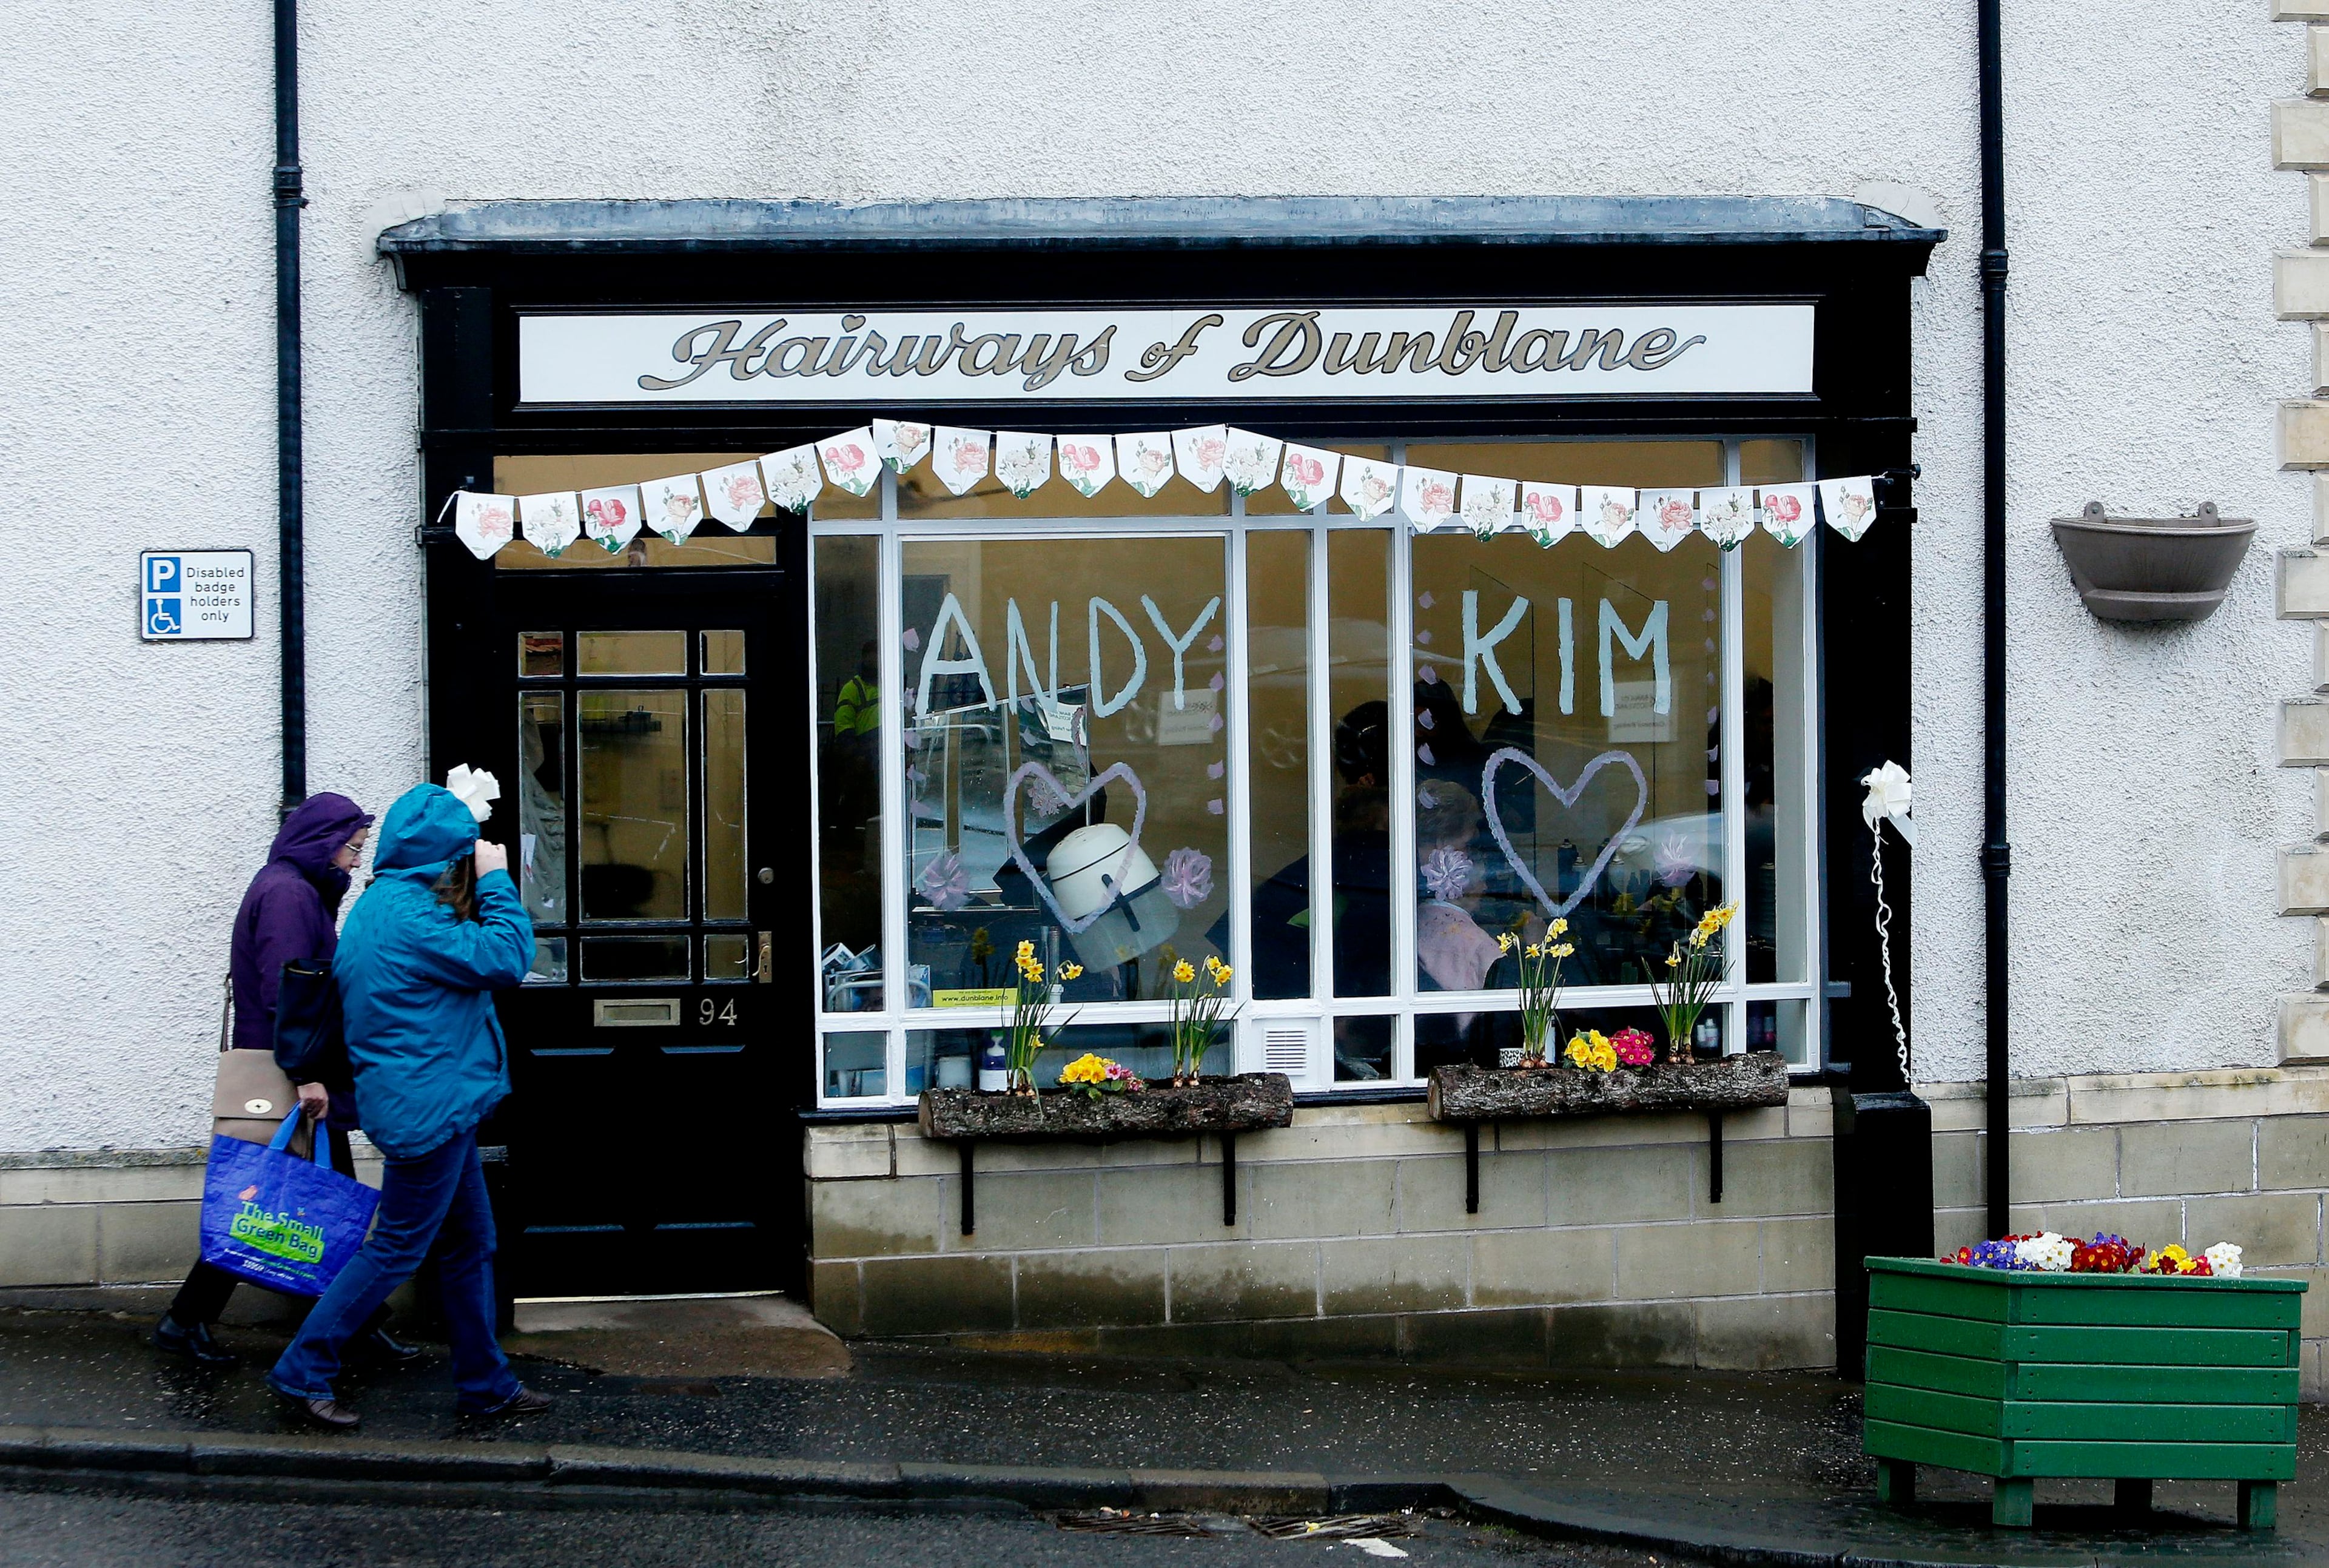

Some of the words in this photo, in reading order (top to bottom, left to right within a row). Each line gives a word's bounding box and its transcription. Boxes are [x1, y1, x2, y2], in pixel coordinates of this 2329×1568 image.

[637, 314, 1117, 391] Hairways
[1124, 313, 1224, 382] of
[1228, 310, 1707, 382] Dunblane
[152, 559, 176, 590] P
[186, 567, 244, 578] Disabled
[195, 582, 236, 594] badge
[190, 596, 240, 607] holders
[201, 610, 230, 622] only
[915, 592, 1222, 719] ANDY
[1461, 589, 1671, 717] KIM
[699, 998, 738, 1026] 94
[241, 1200, 274, 1221] The
[277, 1212, 325, 1242] Small
[237, 1218, 286, 1244] Green
[287, 1233, 318, 1258] Bag
